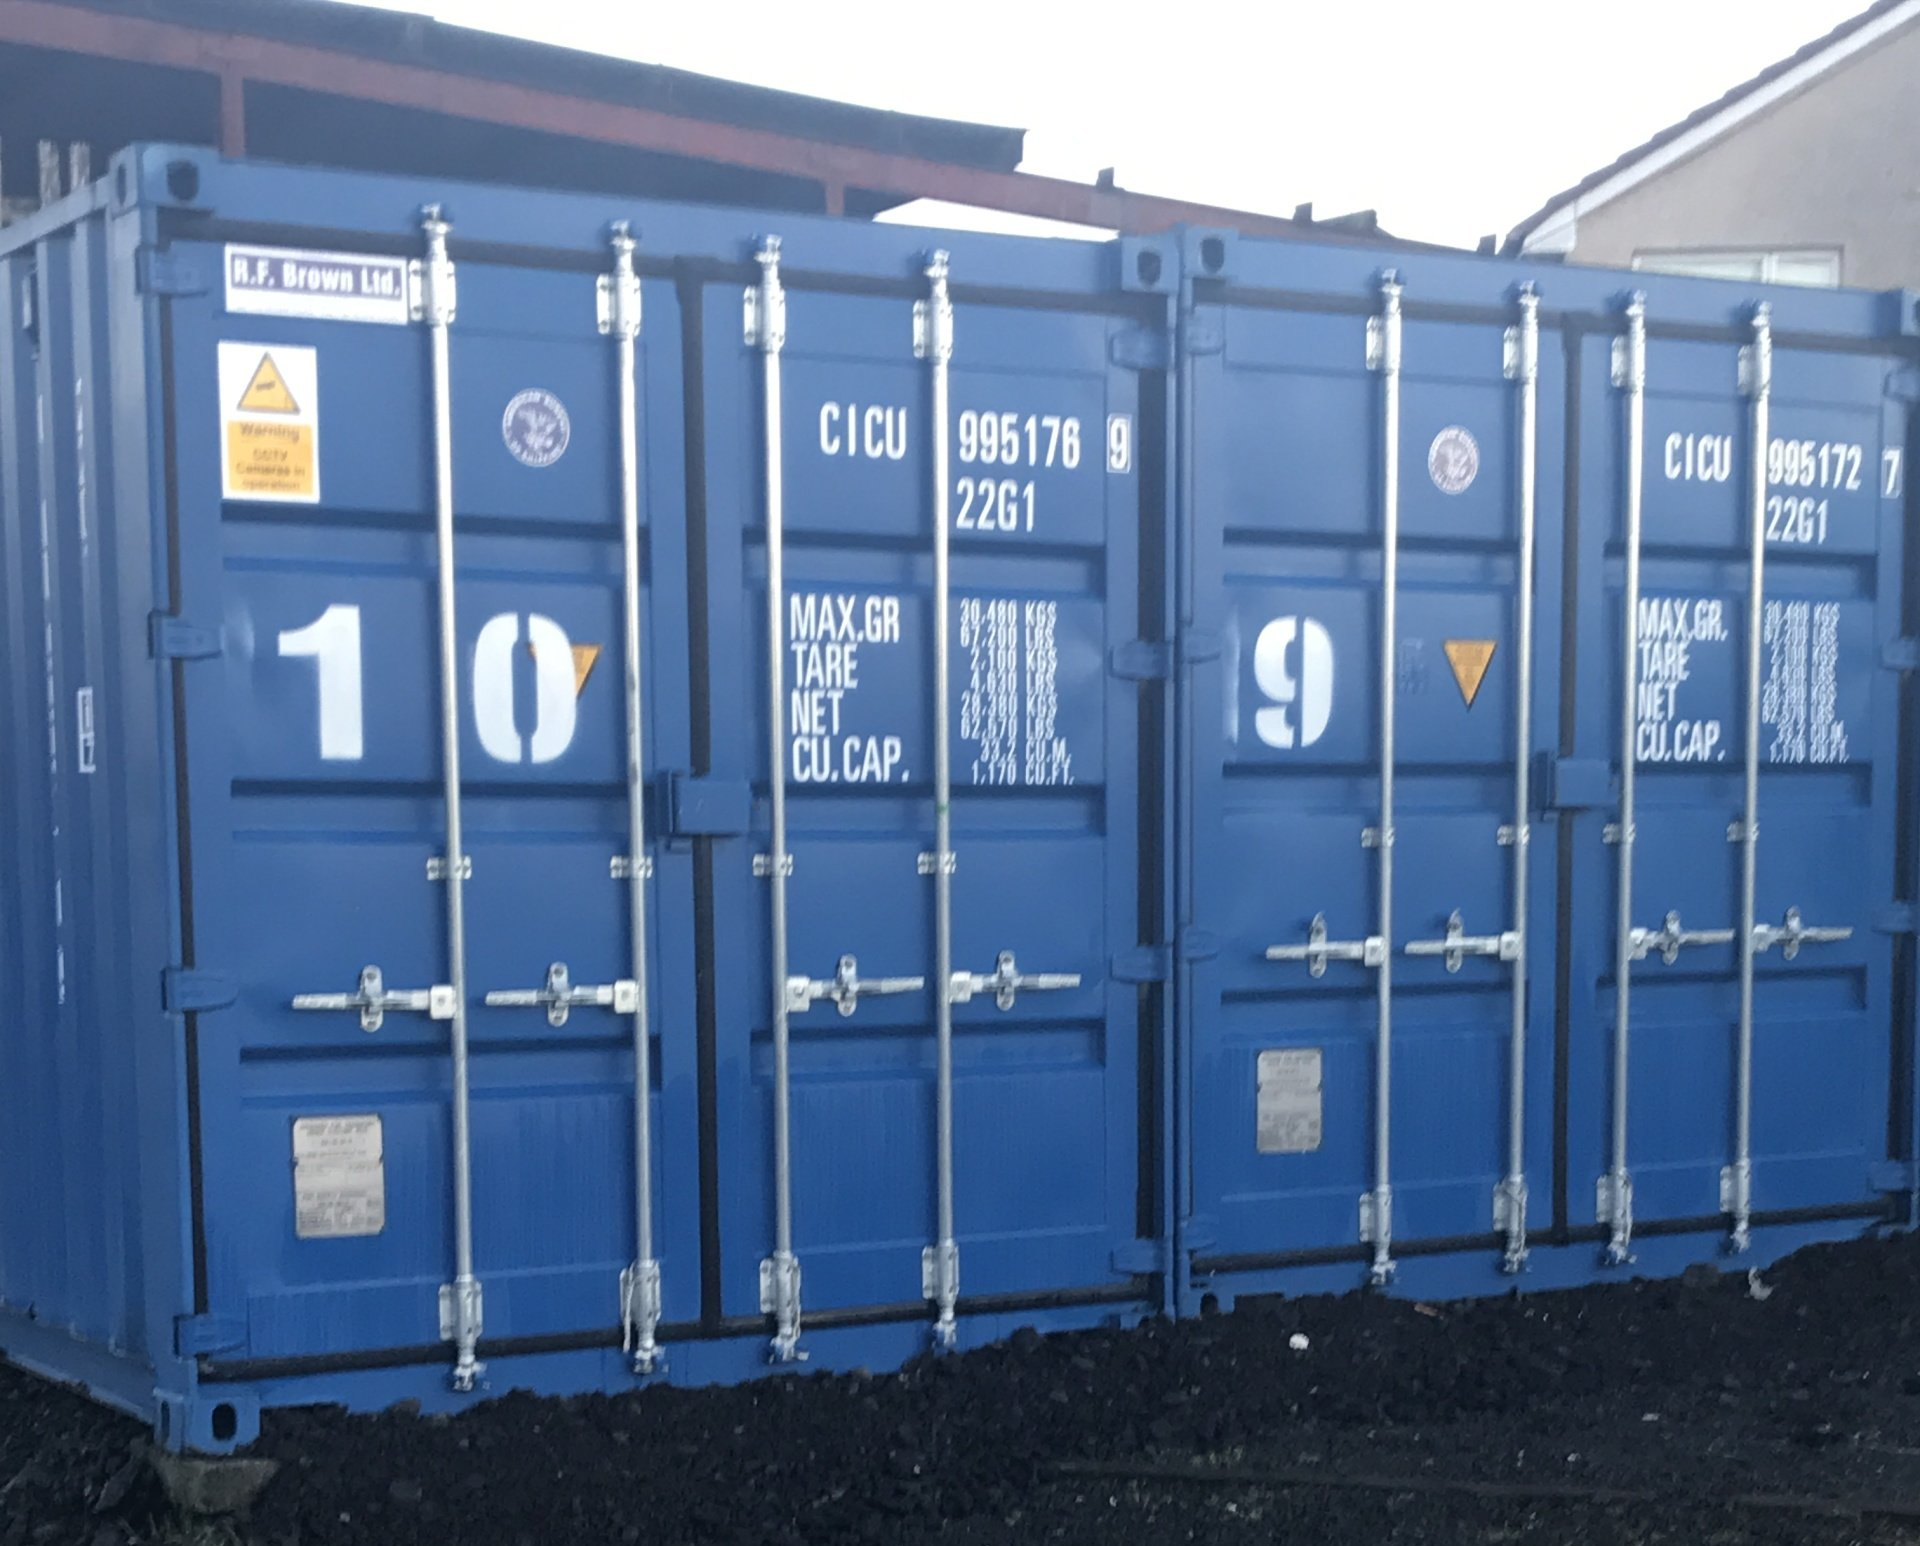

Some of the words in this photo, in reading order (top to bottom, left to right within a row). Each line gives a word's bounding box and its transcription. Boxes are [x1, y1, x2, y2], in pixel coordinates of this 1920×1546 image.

[283, 260, 353, 293] Brown
[361, 266, 400, 297] Ltd.
[819, 401, 907, 459] CICU
[958, 409, 1080, 470] 995176
[1109, 417, 1130, 470] 9
[1664, 432, 1731, 482] CICU
[1768, 438, 1861, 491] 995172
[1884, 449, 1900, 495] 7
[955, 476, 1035, 533] 22G1
[1766, 495, 1828, 544] 22G1
[790, 642, 858, 688] TARE
[1254, 615, 1334, 749] 9
[1639, 640, 1690, 680] TARE
[791, 689, 844, 735] NET
[1637, 680, 1678, 721] NET
